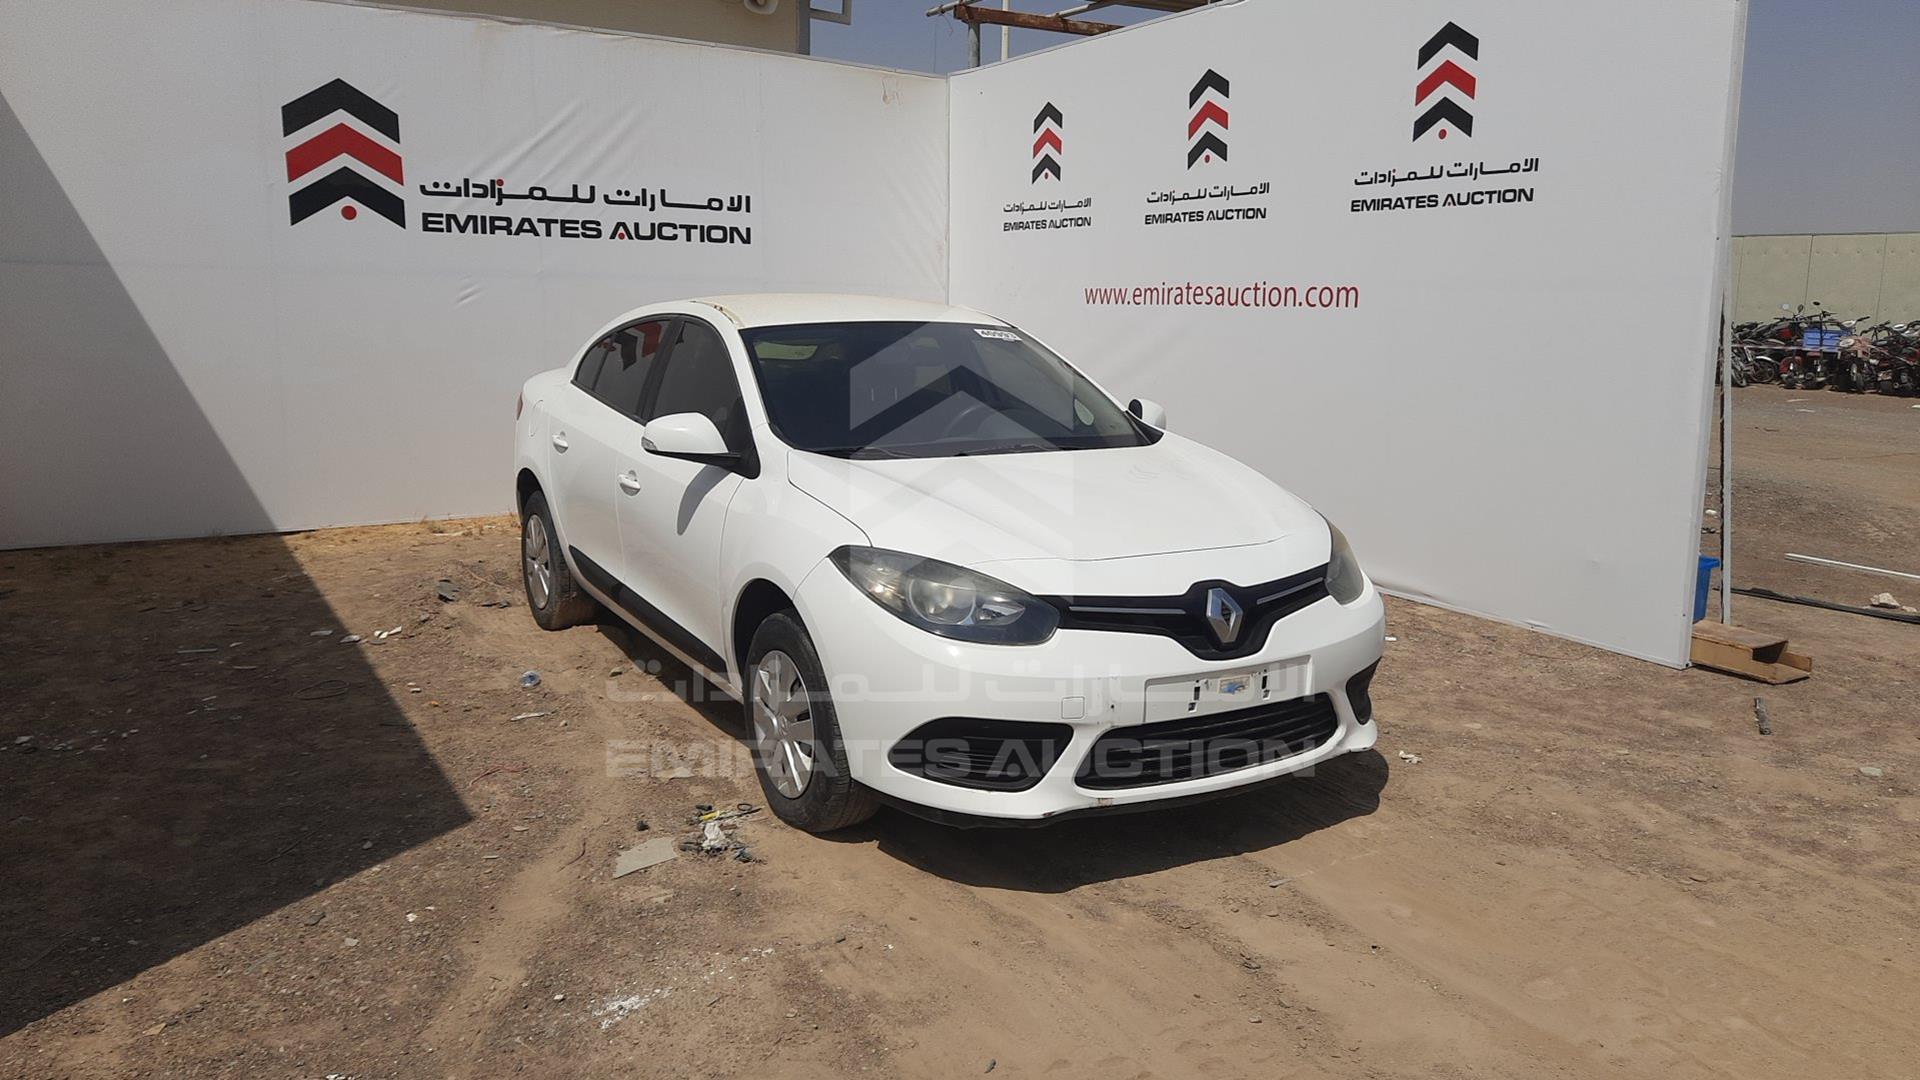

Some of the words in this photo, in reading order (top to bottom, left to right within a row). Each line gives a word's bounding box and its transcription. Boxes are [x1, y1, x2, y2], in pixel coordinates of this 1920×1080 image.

[1354, 165, 1444, 187] للمزادات
[1447, 158, 1539, 181] الامارات
[419, 178, 596, 206] للمزادات
[603, 188, 751, 213] الامارات
[1350, 194, 1439, 212] EMIRATES
[1442, 188, 1535, 207] AUCTION
[422, 211, 602, 239] EMIRATES
[609, 221, 751, 245] AUCTION
[1003, 219, 1047, 232] EMIRATES
[1048, 216, 1092, 229] AUCTION
[1145, 210, 1204, 225] EMIRATES
[1206, 207, 1267, 221] AUCTION
[1084, 281, 1360, 309] www.emiratesauction.com
